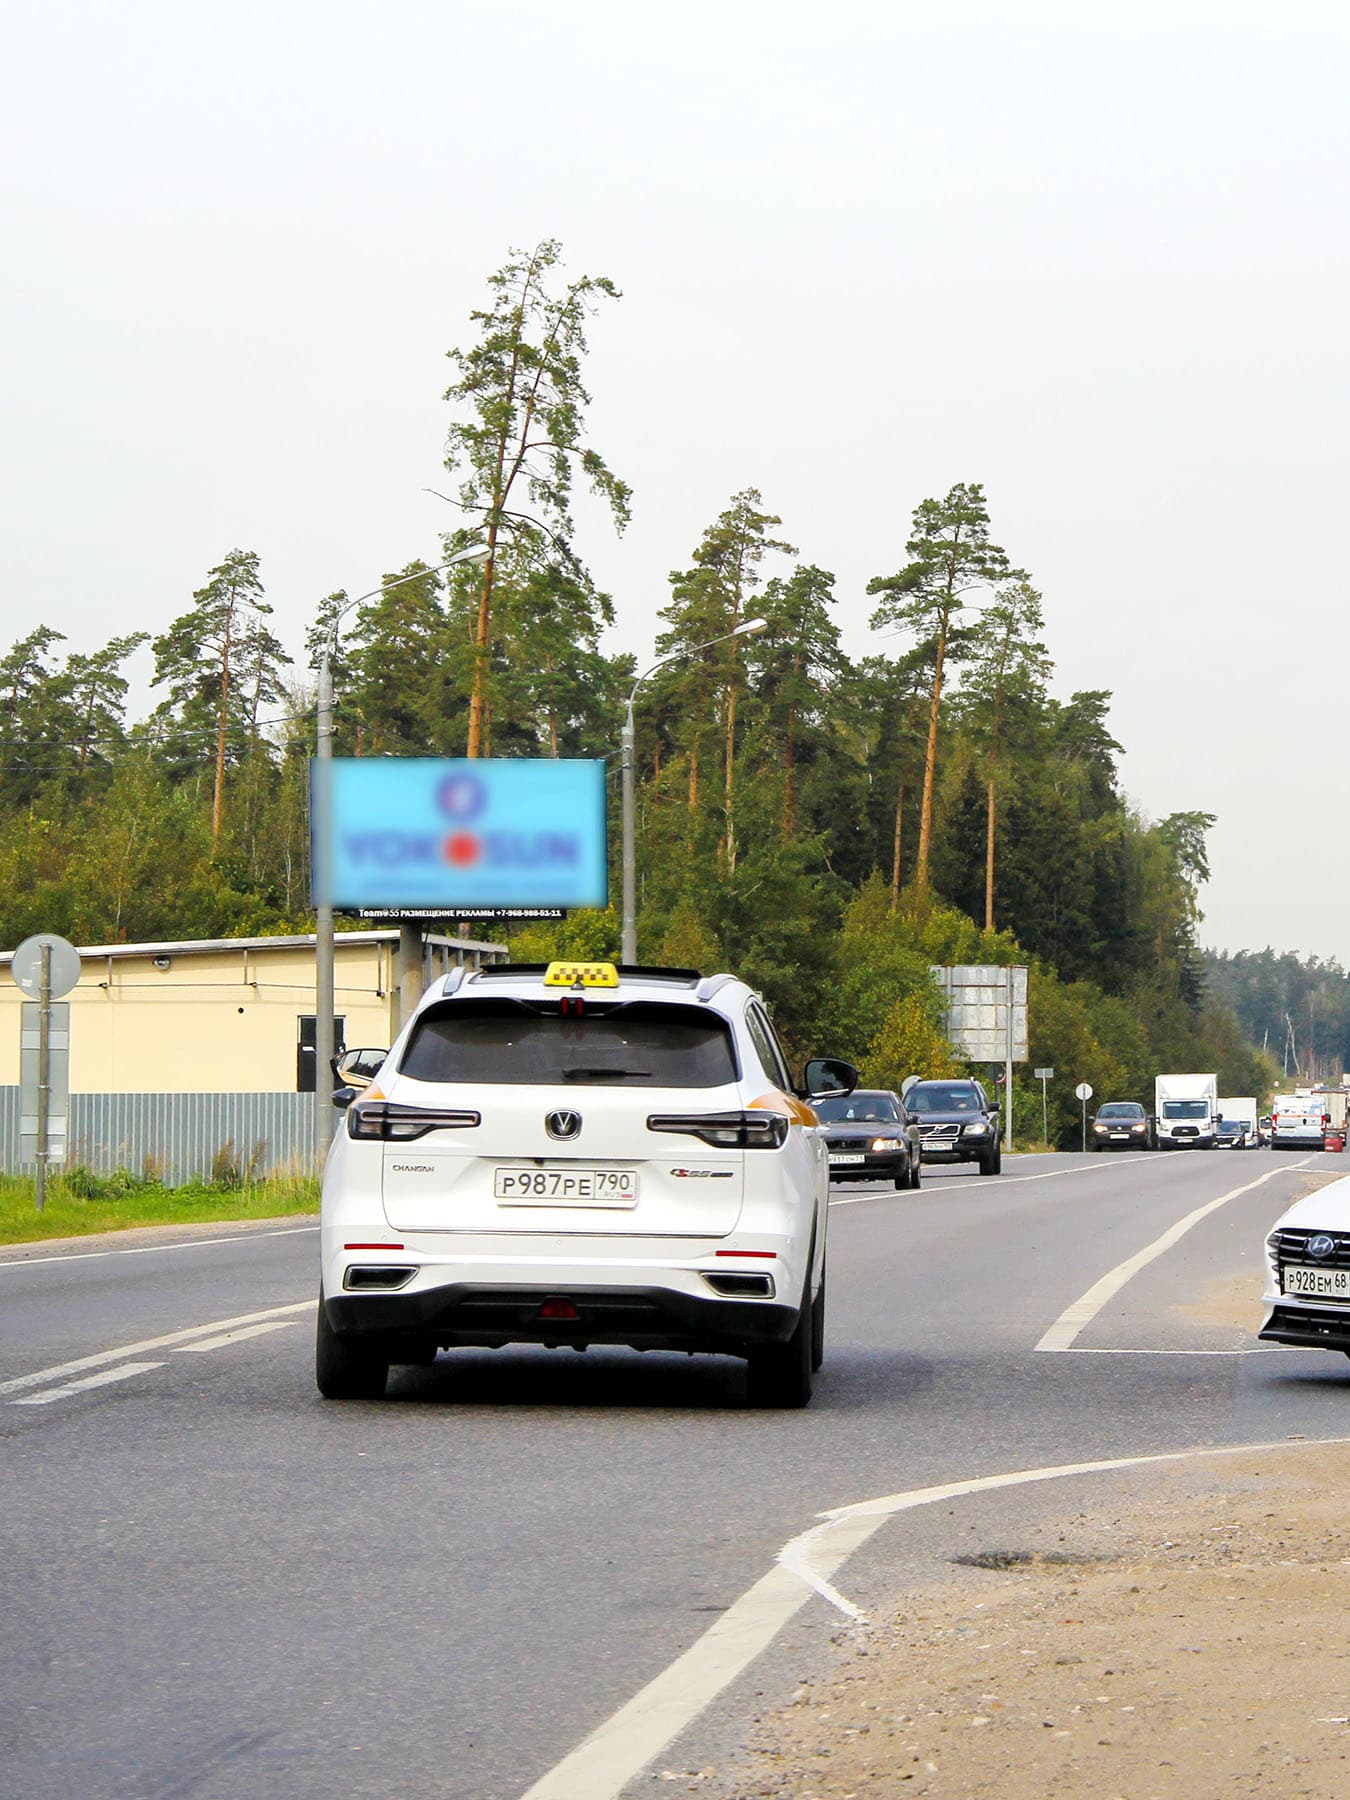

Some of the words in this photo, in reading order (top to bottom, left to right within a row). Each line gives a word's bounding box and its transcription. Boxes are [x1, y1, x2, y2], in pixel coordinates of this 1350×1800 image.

[392, 1164, 435, 1173] CHANGAN
[596, 1173, 630, 1190] 790
[1334, 1273, 1347, 1289] 68
